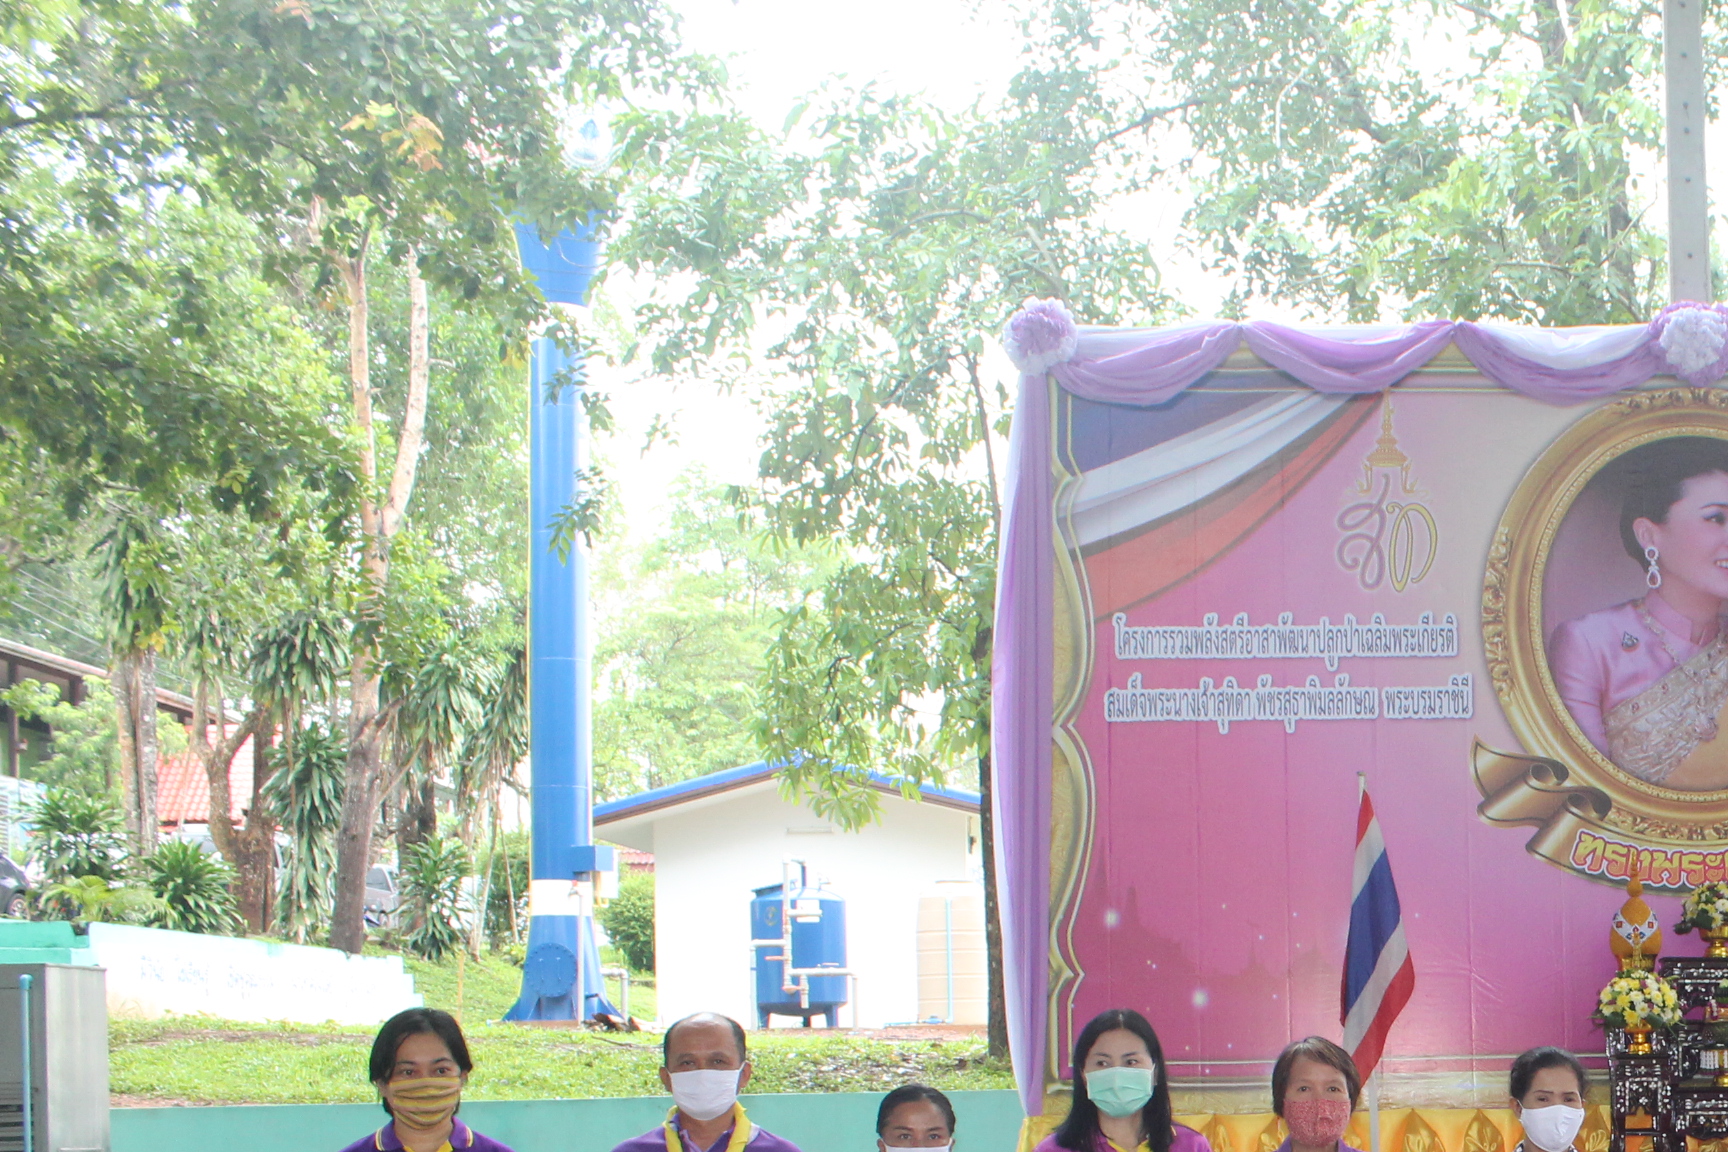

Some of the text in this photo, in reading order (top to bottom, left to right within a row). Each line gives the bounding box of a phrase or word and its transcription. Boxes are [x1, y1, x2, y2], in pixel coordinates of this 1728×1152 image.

[1115, 613, 1457, 668] โครงการรวมพลังสตรีอาสาพัฒนาปลูกป่าเฉลิมพระเกียรติ
[1106, 674, 1252, 732] สมเด็จพระนางเจ้าสุทิดา
[1384, 674, 1471, 717] พระบรมราชินี
